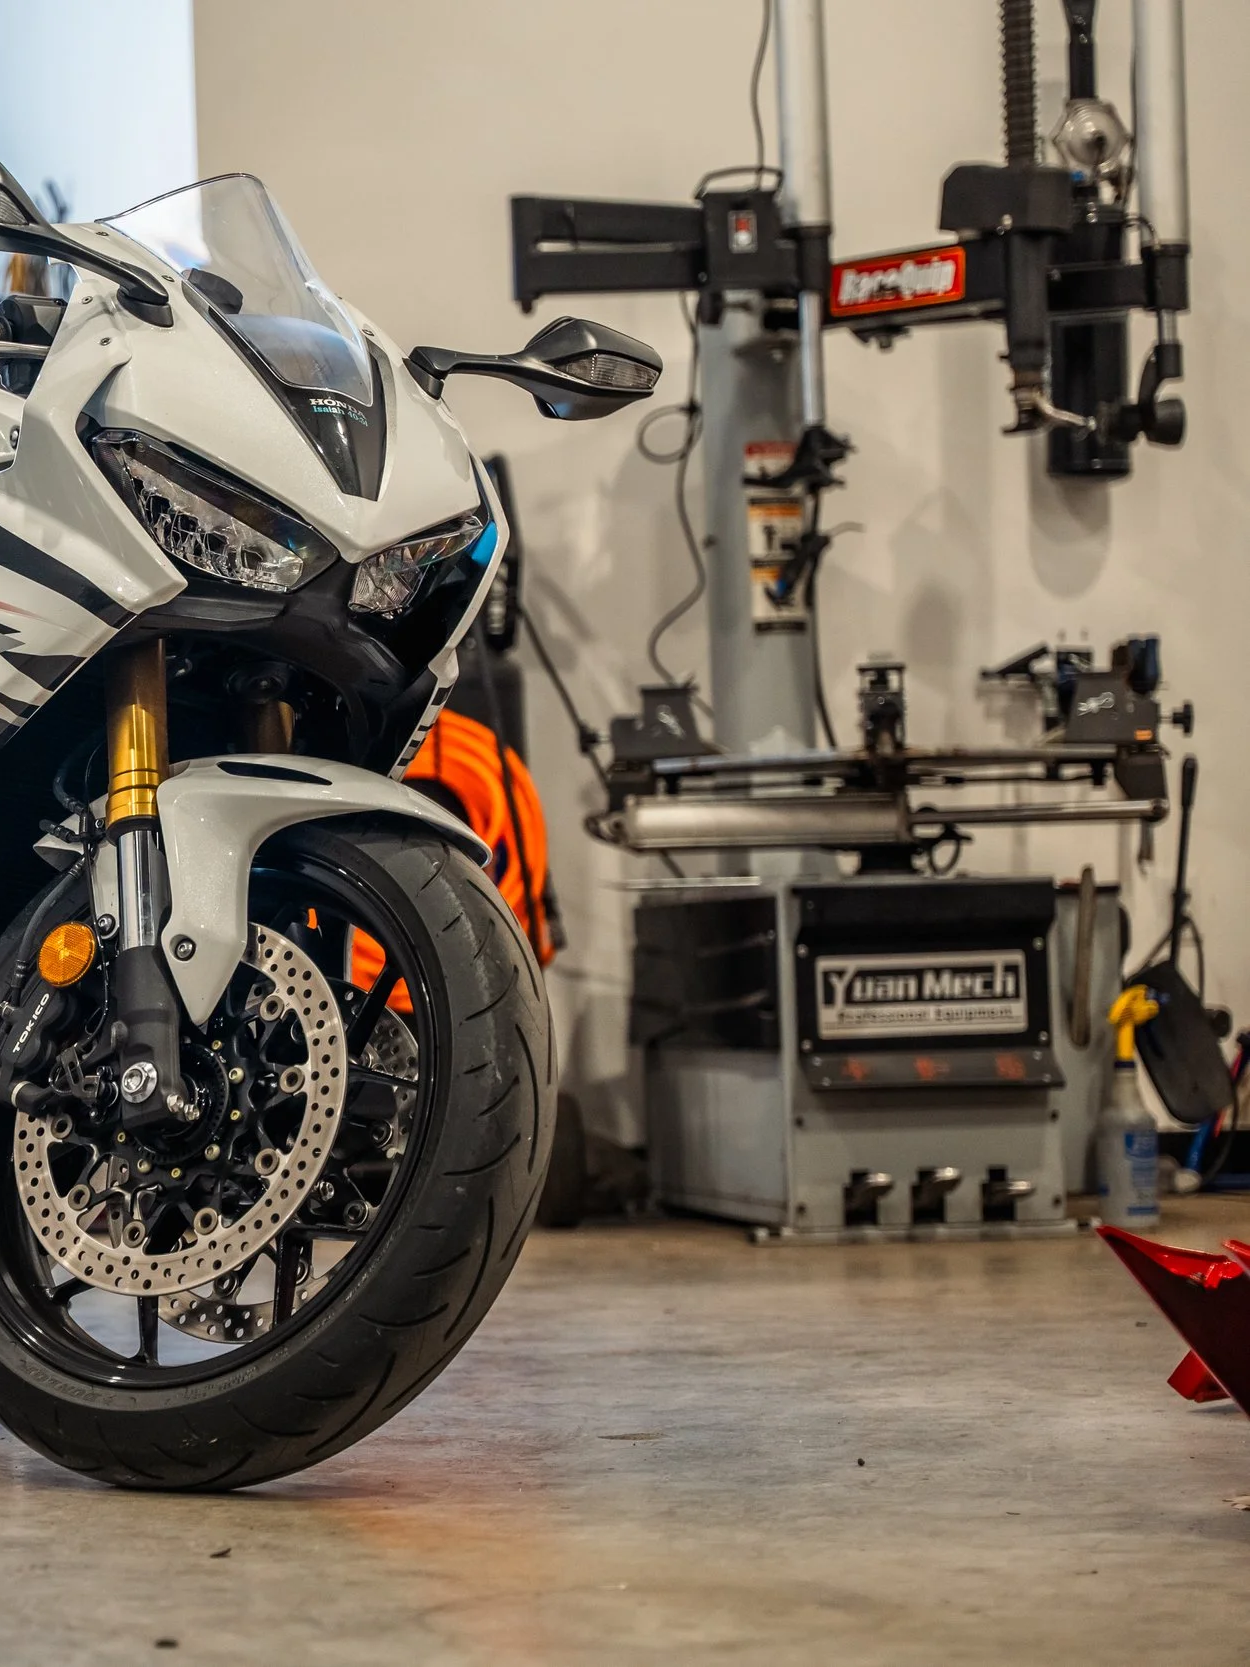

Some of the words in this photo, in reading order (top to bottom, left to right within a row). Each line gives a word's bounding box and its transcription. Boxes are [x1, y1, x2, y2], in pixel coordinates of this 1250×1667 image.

[309, 398, 367, 419] HONDA
[312, 405, 345, 415] Isaiah
[828, 965, 918, 1009] Yuan
[922, 961, 1016, 1000] Mech
[12, 993, 50, 1053] TOKICO
